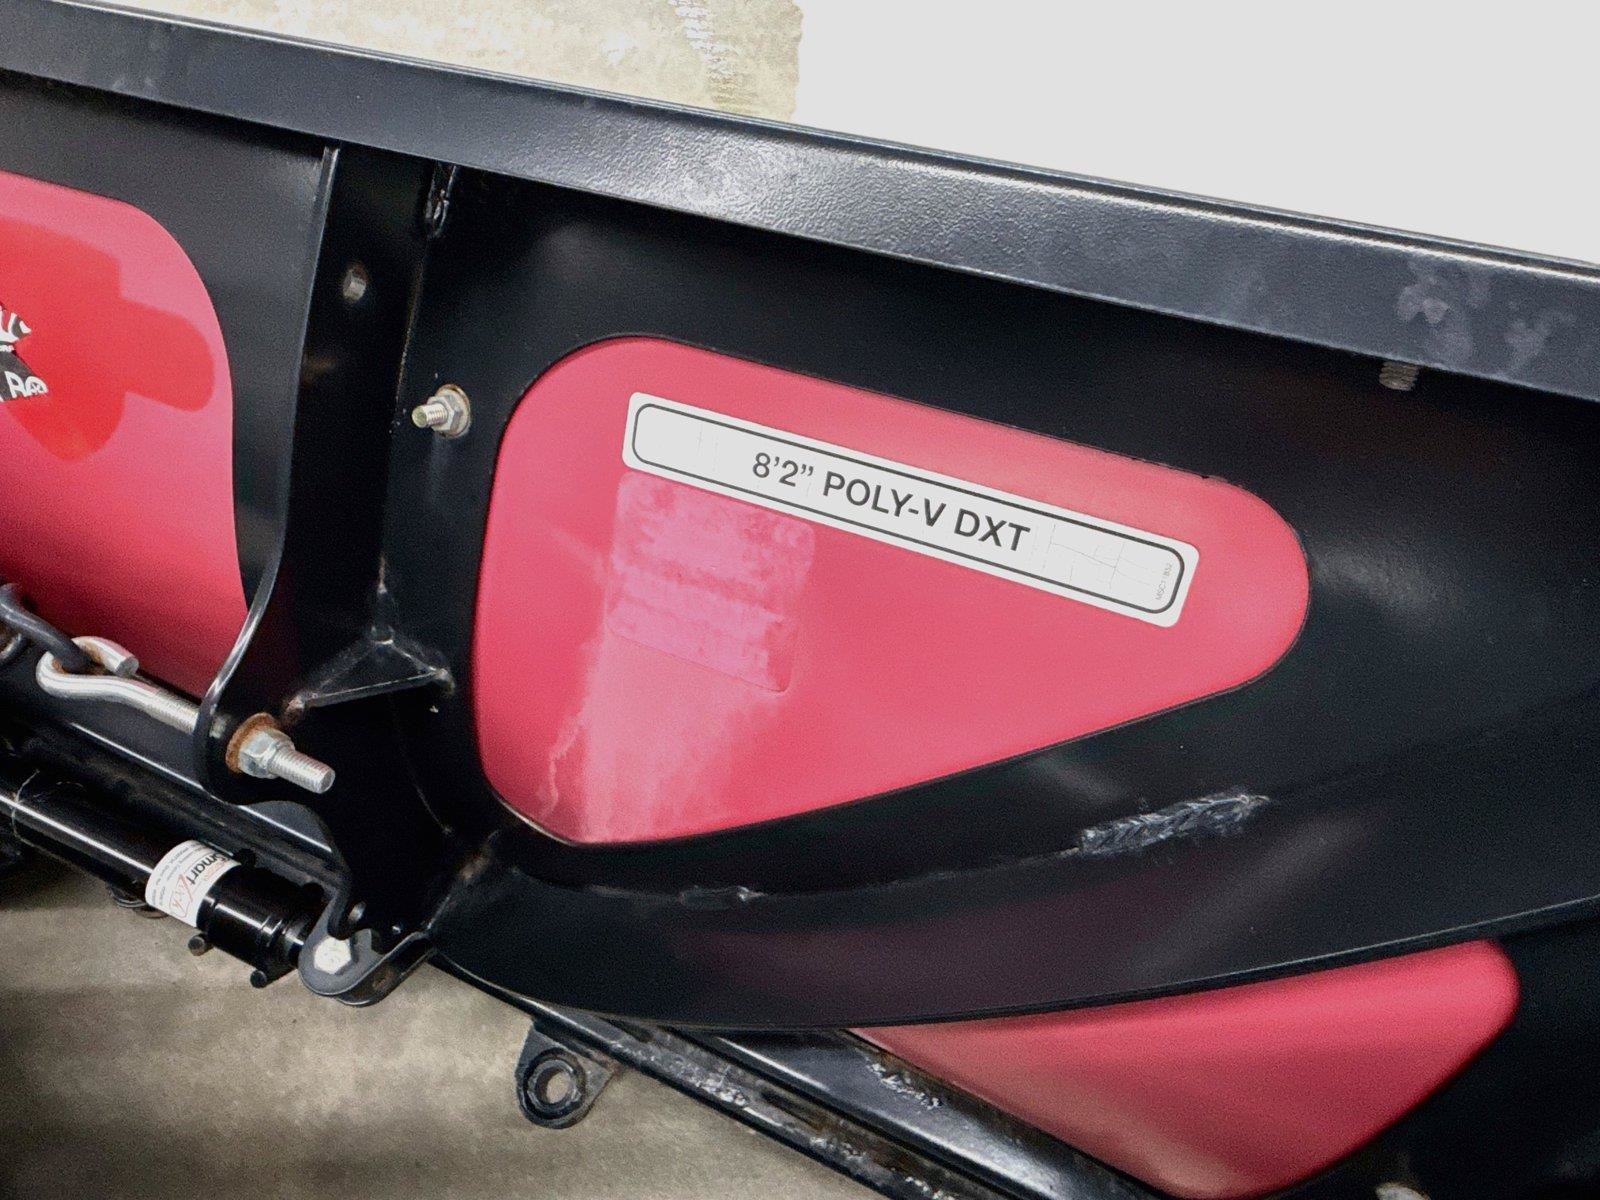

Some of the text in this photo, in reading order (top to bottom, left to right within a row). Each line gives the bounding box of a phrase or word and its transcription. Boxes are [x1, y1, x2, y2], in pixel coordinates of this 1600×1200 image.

[752, 452, 1031, 552] 8'2" POLY-V DXT
